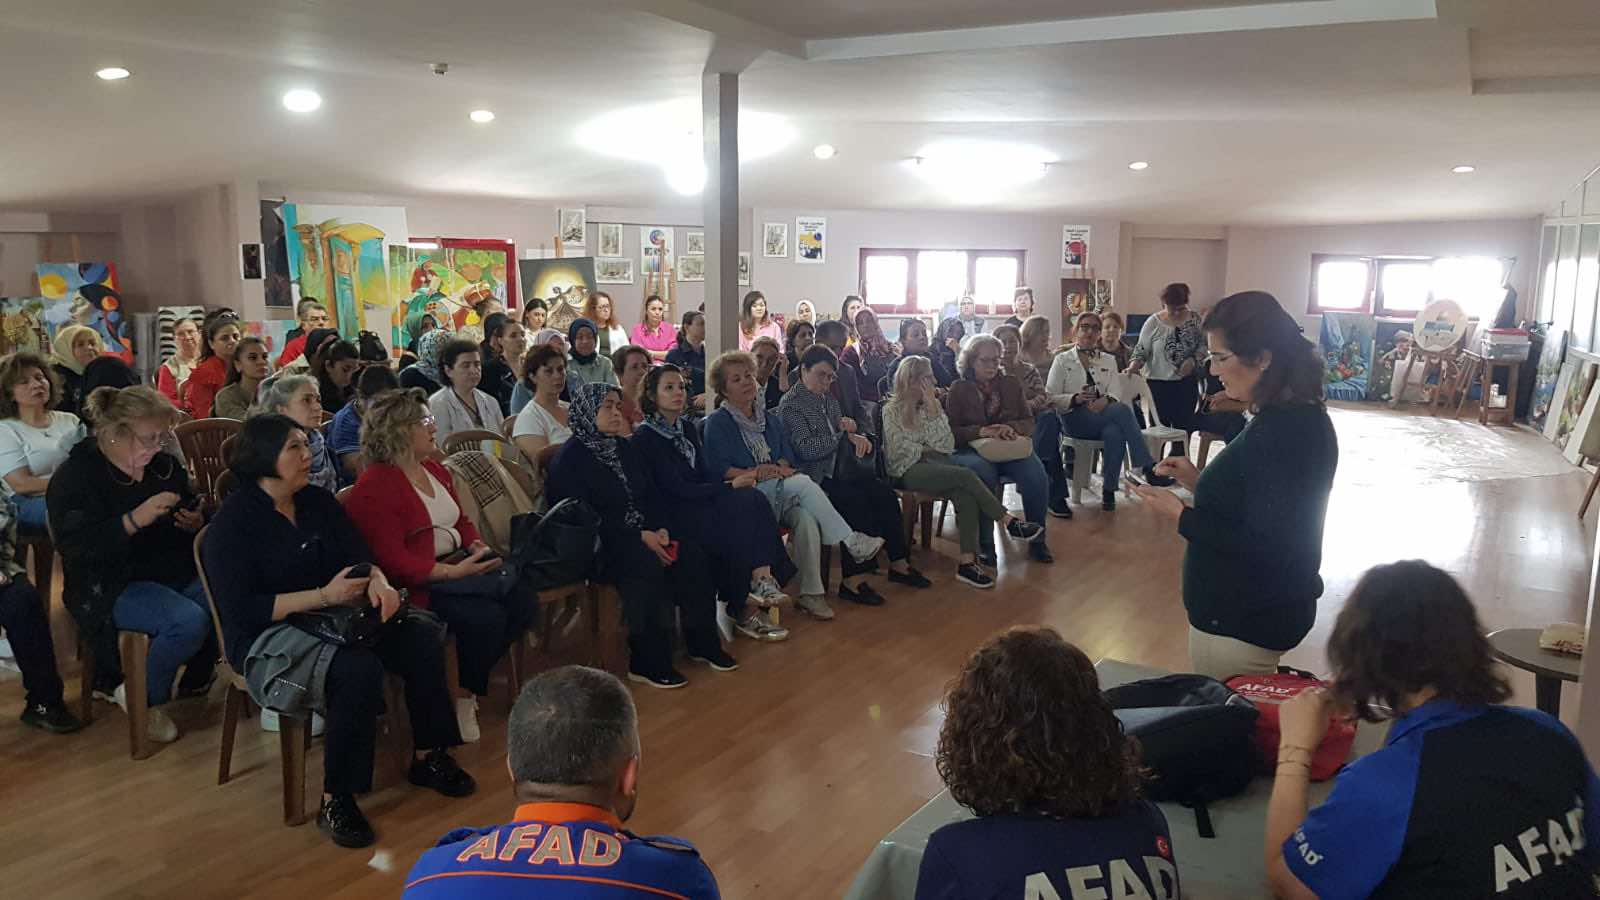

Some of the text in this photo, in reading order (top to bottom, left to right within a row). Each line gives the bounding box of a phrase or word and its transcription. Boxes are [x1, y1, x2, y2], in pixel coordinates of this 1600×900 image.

[1237, 683, 1293, 694] AFAD
[456, 824, 623, 867] AFAD
[1295, 829, 1324, 865] FAD
[1024, 856, 1180, 900] AFAD
